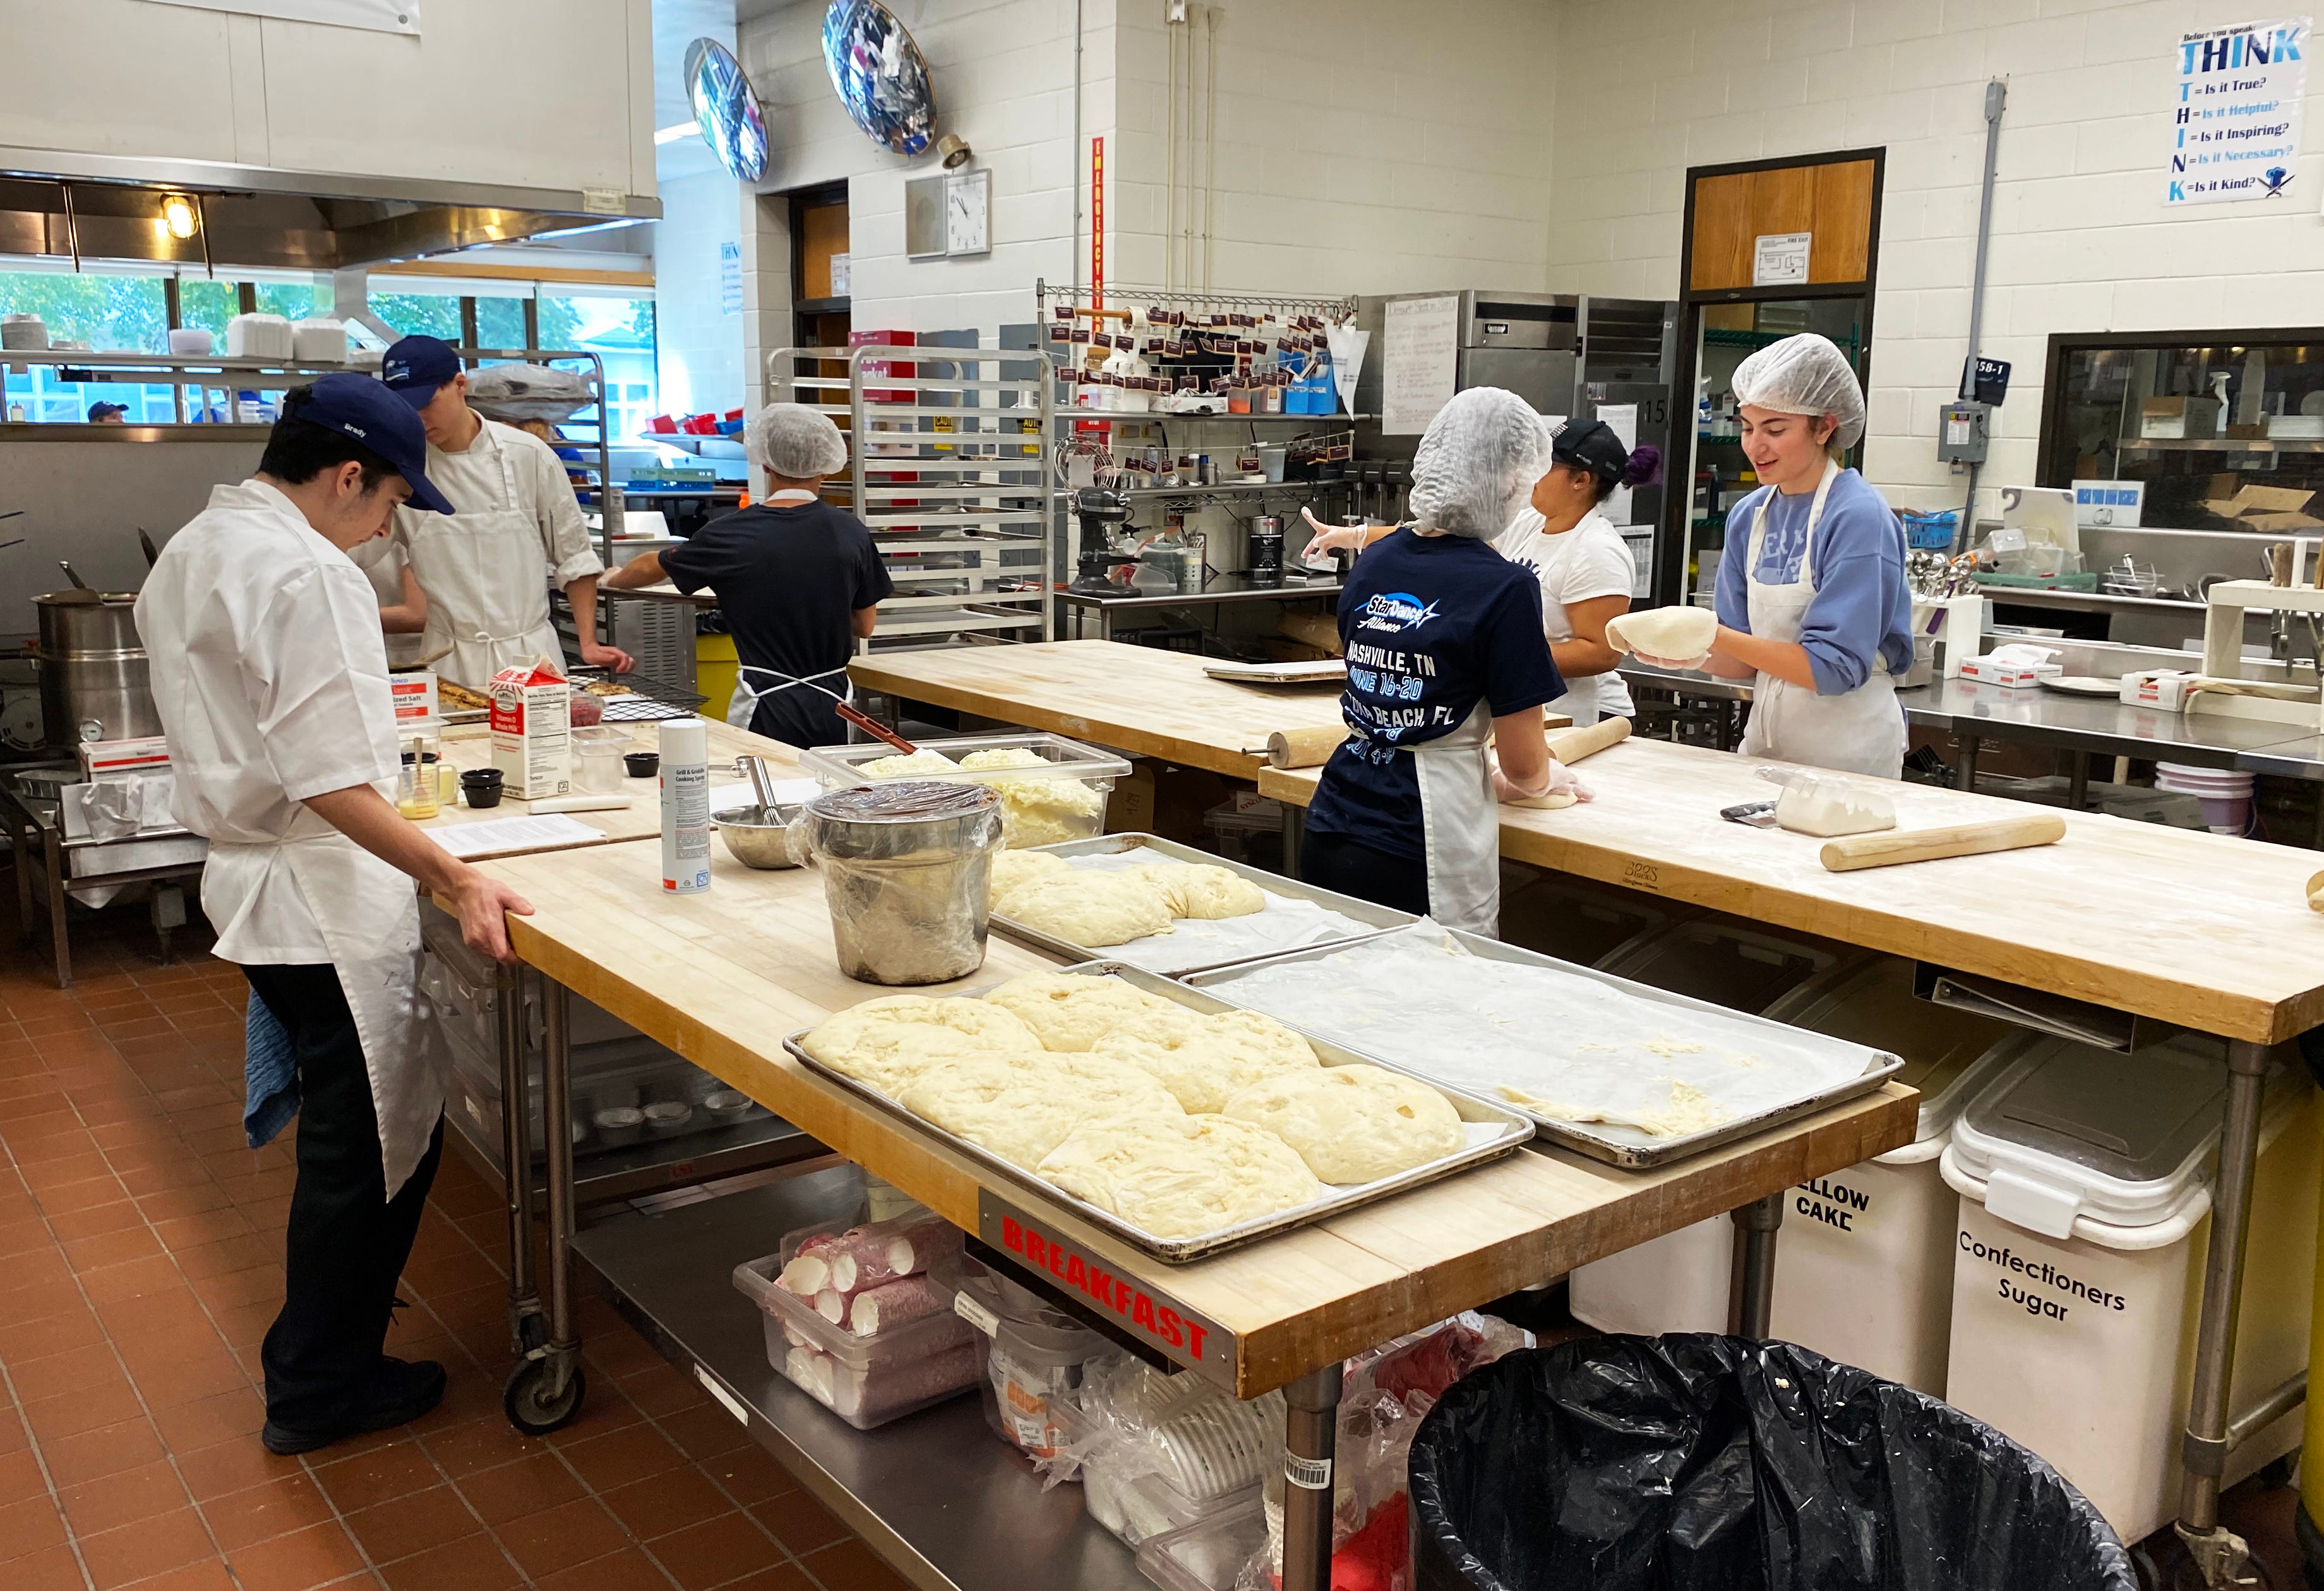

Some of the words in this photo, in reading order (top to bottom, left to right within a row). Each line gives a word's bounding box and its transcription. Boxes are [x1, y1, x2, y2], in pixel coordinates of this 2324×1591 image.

[2184, 32, 2210, 41] Before
[2213, 30, 2226, 38] you
[2180, 27, 2302, 74] THINK
[2180, 82, 2193, 102] T
[2205, 83, 2215, 95] Is
[2220, 82, 2228, 93] it
[2233, 77, 2267, 91] True?
[2177, 107, 2190, 124] H
[2203, 107, 2213, 119] Is
[2217, 106, 2225, 117] it
[2229, 100, 2279, 116] Helpful?
[2177, 128, 2184, 148] I
[2201, 131, 2211, 142] Is
[2215, 129, 2223, 140] it
[2227, 122, 2289, 140] Inspiring?
[2172, 153, 2186, 173] N
[2198, 154, 2209, 164] Is
[2213, 152, 2221, 163] it
[2225, 145, 2293, 163] Necessary?
[2169, 179, 2186, 201] K
[2210, 179, 2217, 191] it
[2221, 177, 2256, 190] Kind?
[1646, 400, 1665, 424] 15
[344, 423, 366, 438] Brady
[1367, 594, 1423, 621] StarDance
[1357, 616, 1401, 633] Alliance
[1347, 640, 1410, 674] NASHVILLE,
[1414, 653, 1435, 676] TN
[1380, 672, 1423, 701] 16-20
[1372, 706, 1425, 727] BEACH,
[1432, 706, 1454, 725] FL
[1797, 1197, 1852, 1232] CAKE
[1960, 1231, 2125, 1311] Confectioners
[1002, 1215, 1208, 1361] BREAKFAST
[1998, 1278, 2068, 1321] Sugar
